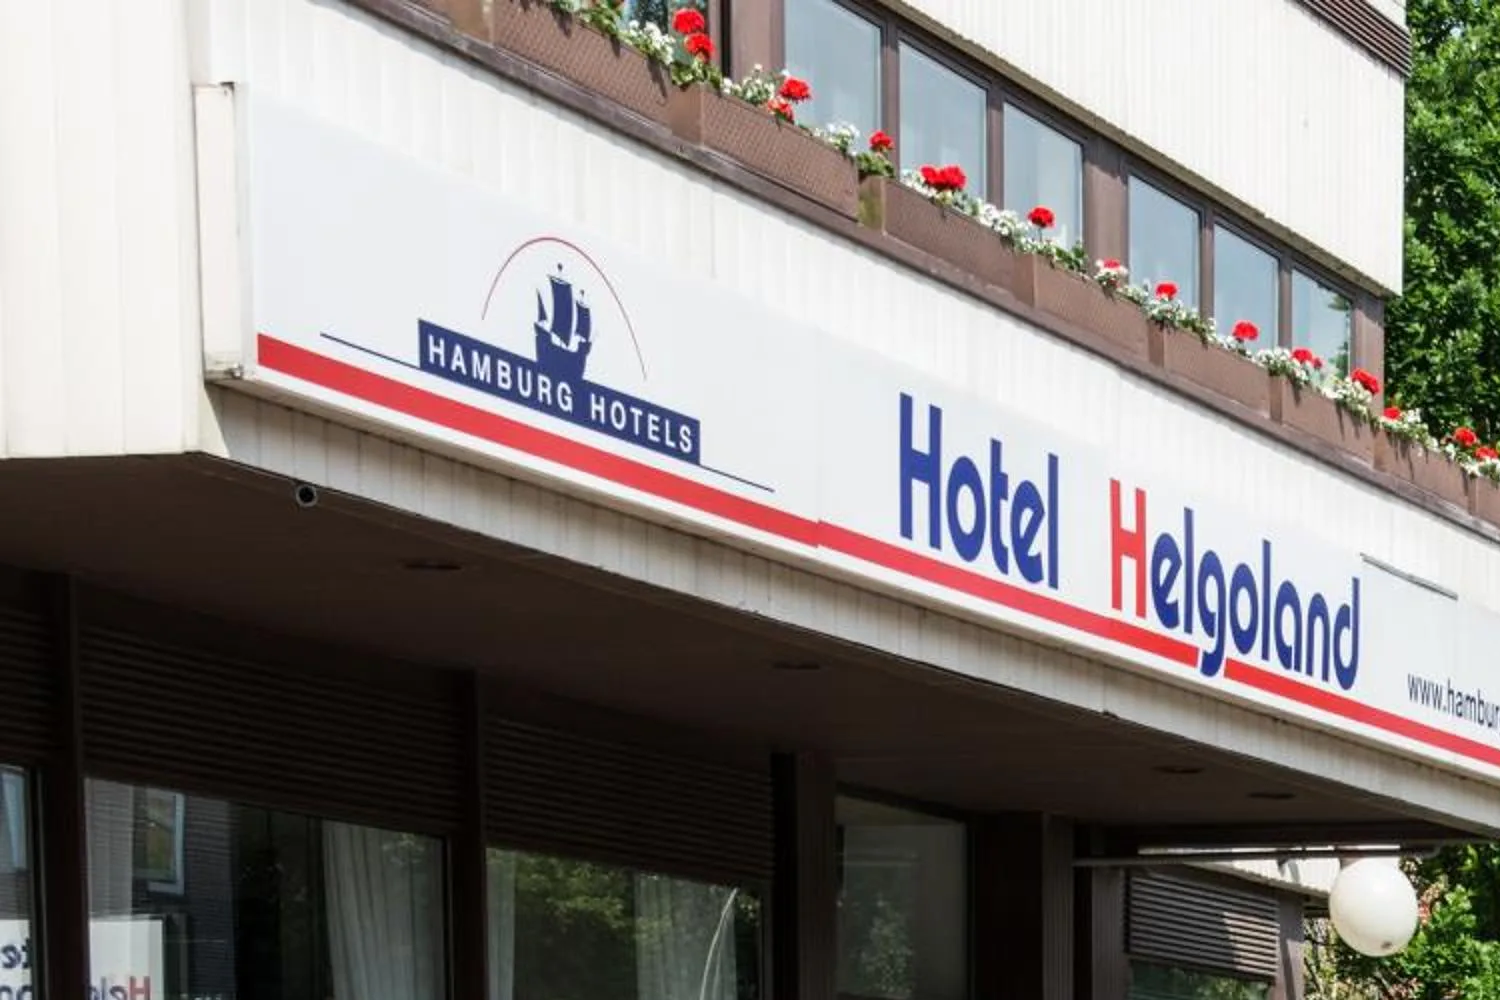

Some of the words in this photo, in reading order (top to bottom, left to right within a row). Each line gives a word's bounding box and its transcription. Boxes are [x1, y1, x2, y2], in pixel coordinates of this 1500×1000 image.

[428, 333, 574, 413] HAMBURG
[590, 392, 693, 454] HOTELS
[900, 391, 1059, 590] Hotel
[1109, 477, 1360, 691] Helgoland
